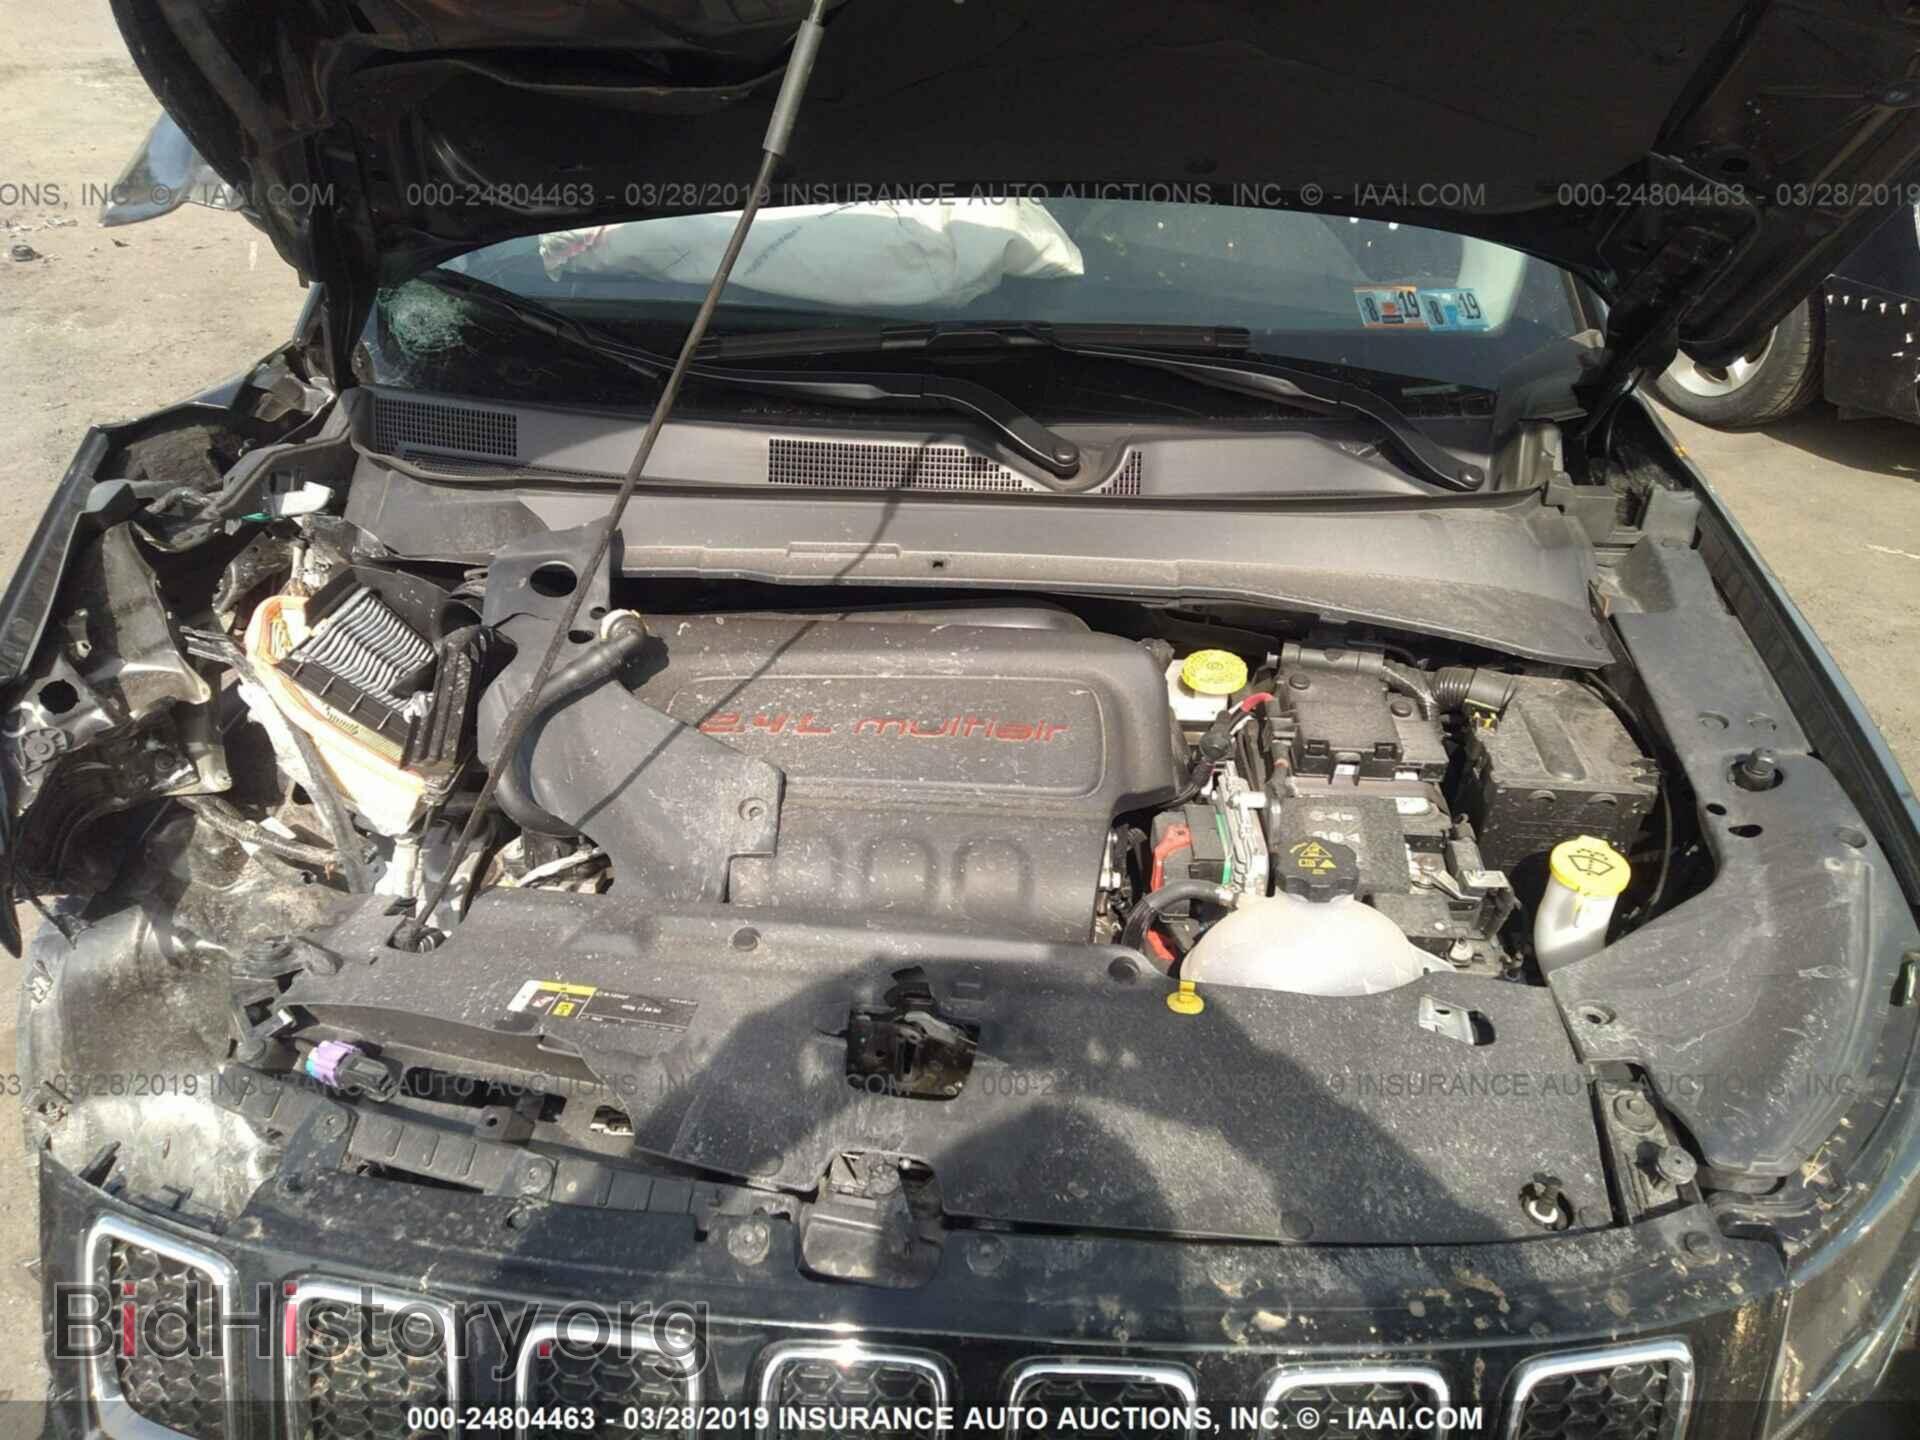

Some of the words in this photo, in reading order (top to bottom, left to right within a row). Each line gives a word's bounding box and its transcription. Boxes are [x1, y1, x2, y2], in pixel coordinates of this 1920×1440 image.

[1399, 290, 1421, 318] 19
[1459, 291, 1481, 320] 19
[851, 711, 1071, 742] multiair
